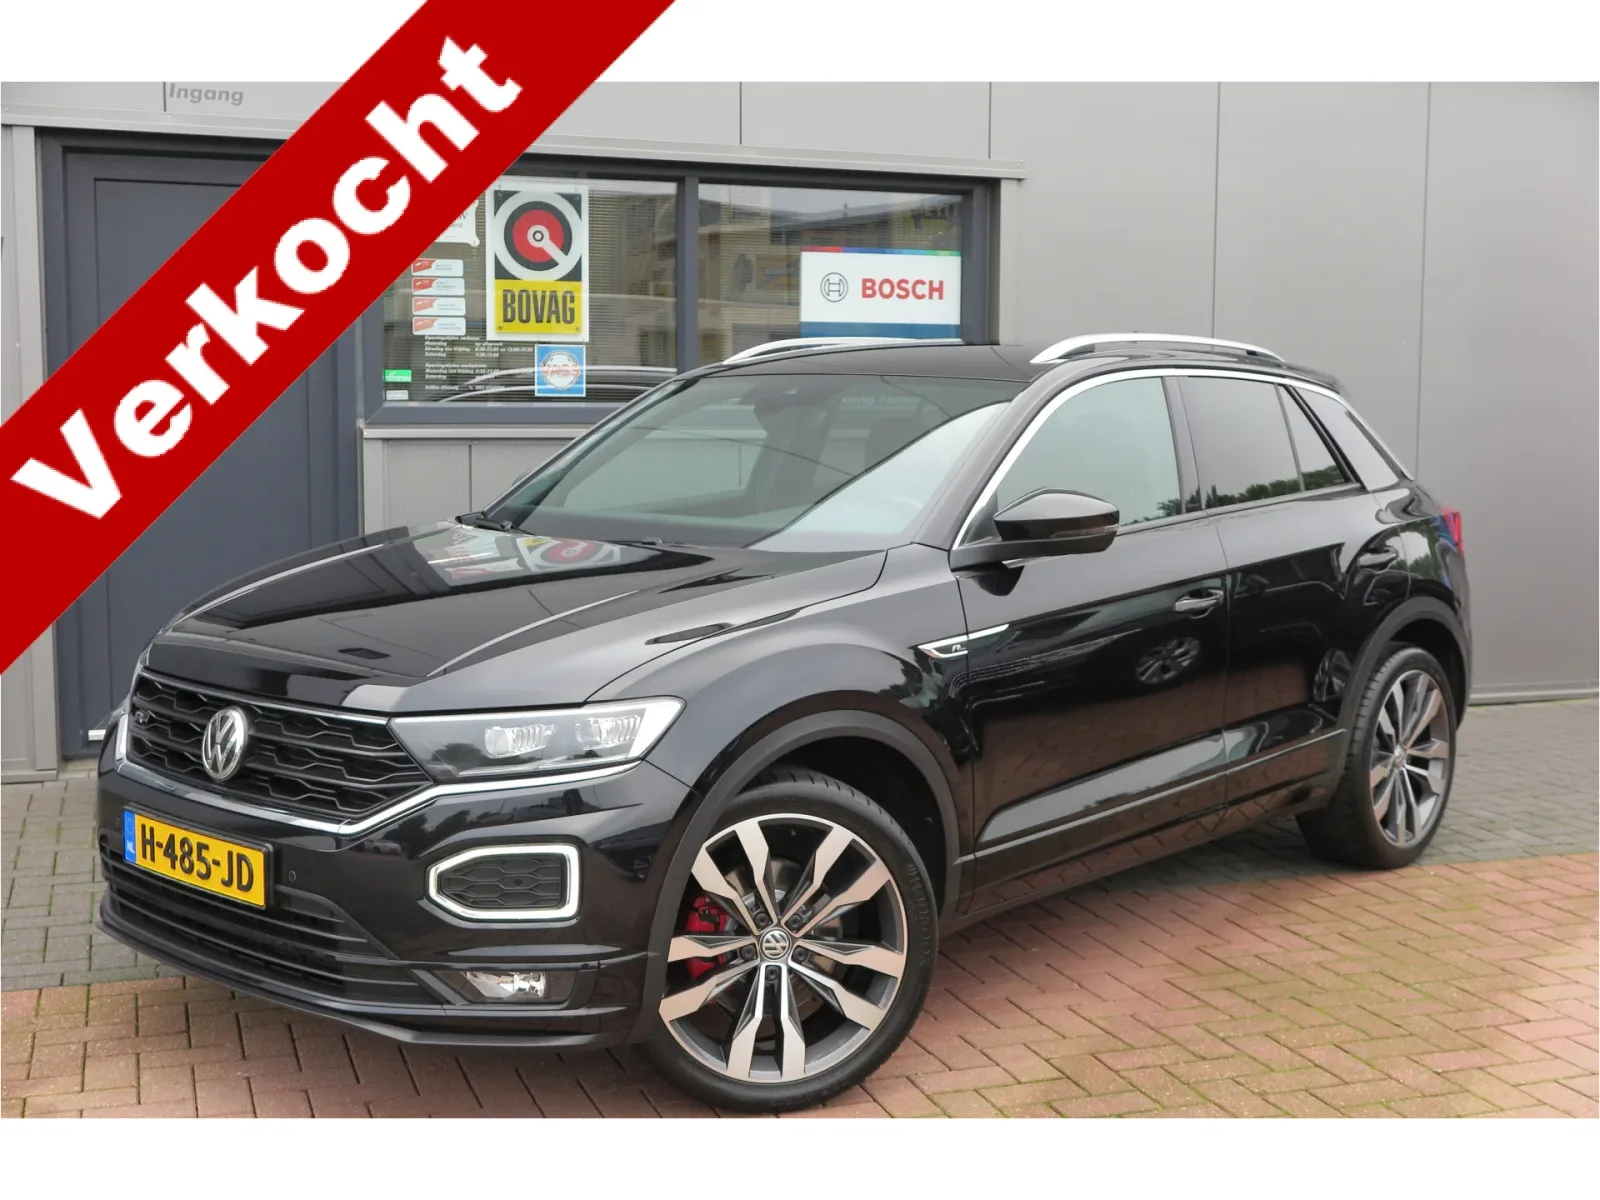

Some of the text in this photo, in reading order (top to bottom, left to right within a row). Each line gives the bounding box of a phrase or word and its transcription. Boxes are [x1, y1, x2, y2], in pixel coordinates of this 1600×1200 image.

[168, 82, 244, 106] Ingang
[861, 278, 944, 300] BOSCH
[502, 289, 576, 324] BOVAG
[140, 823, 254, 893] H-485-JD
